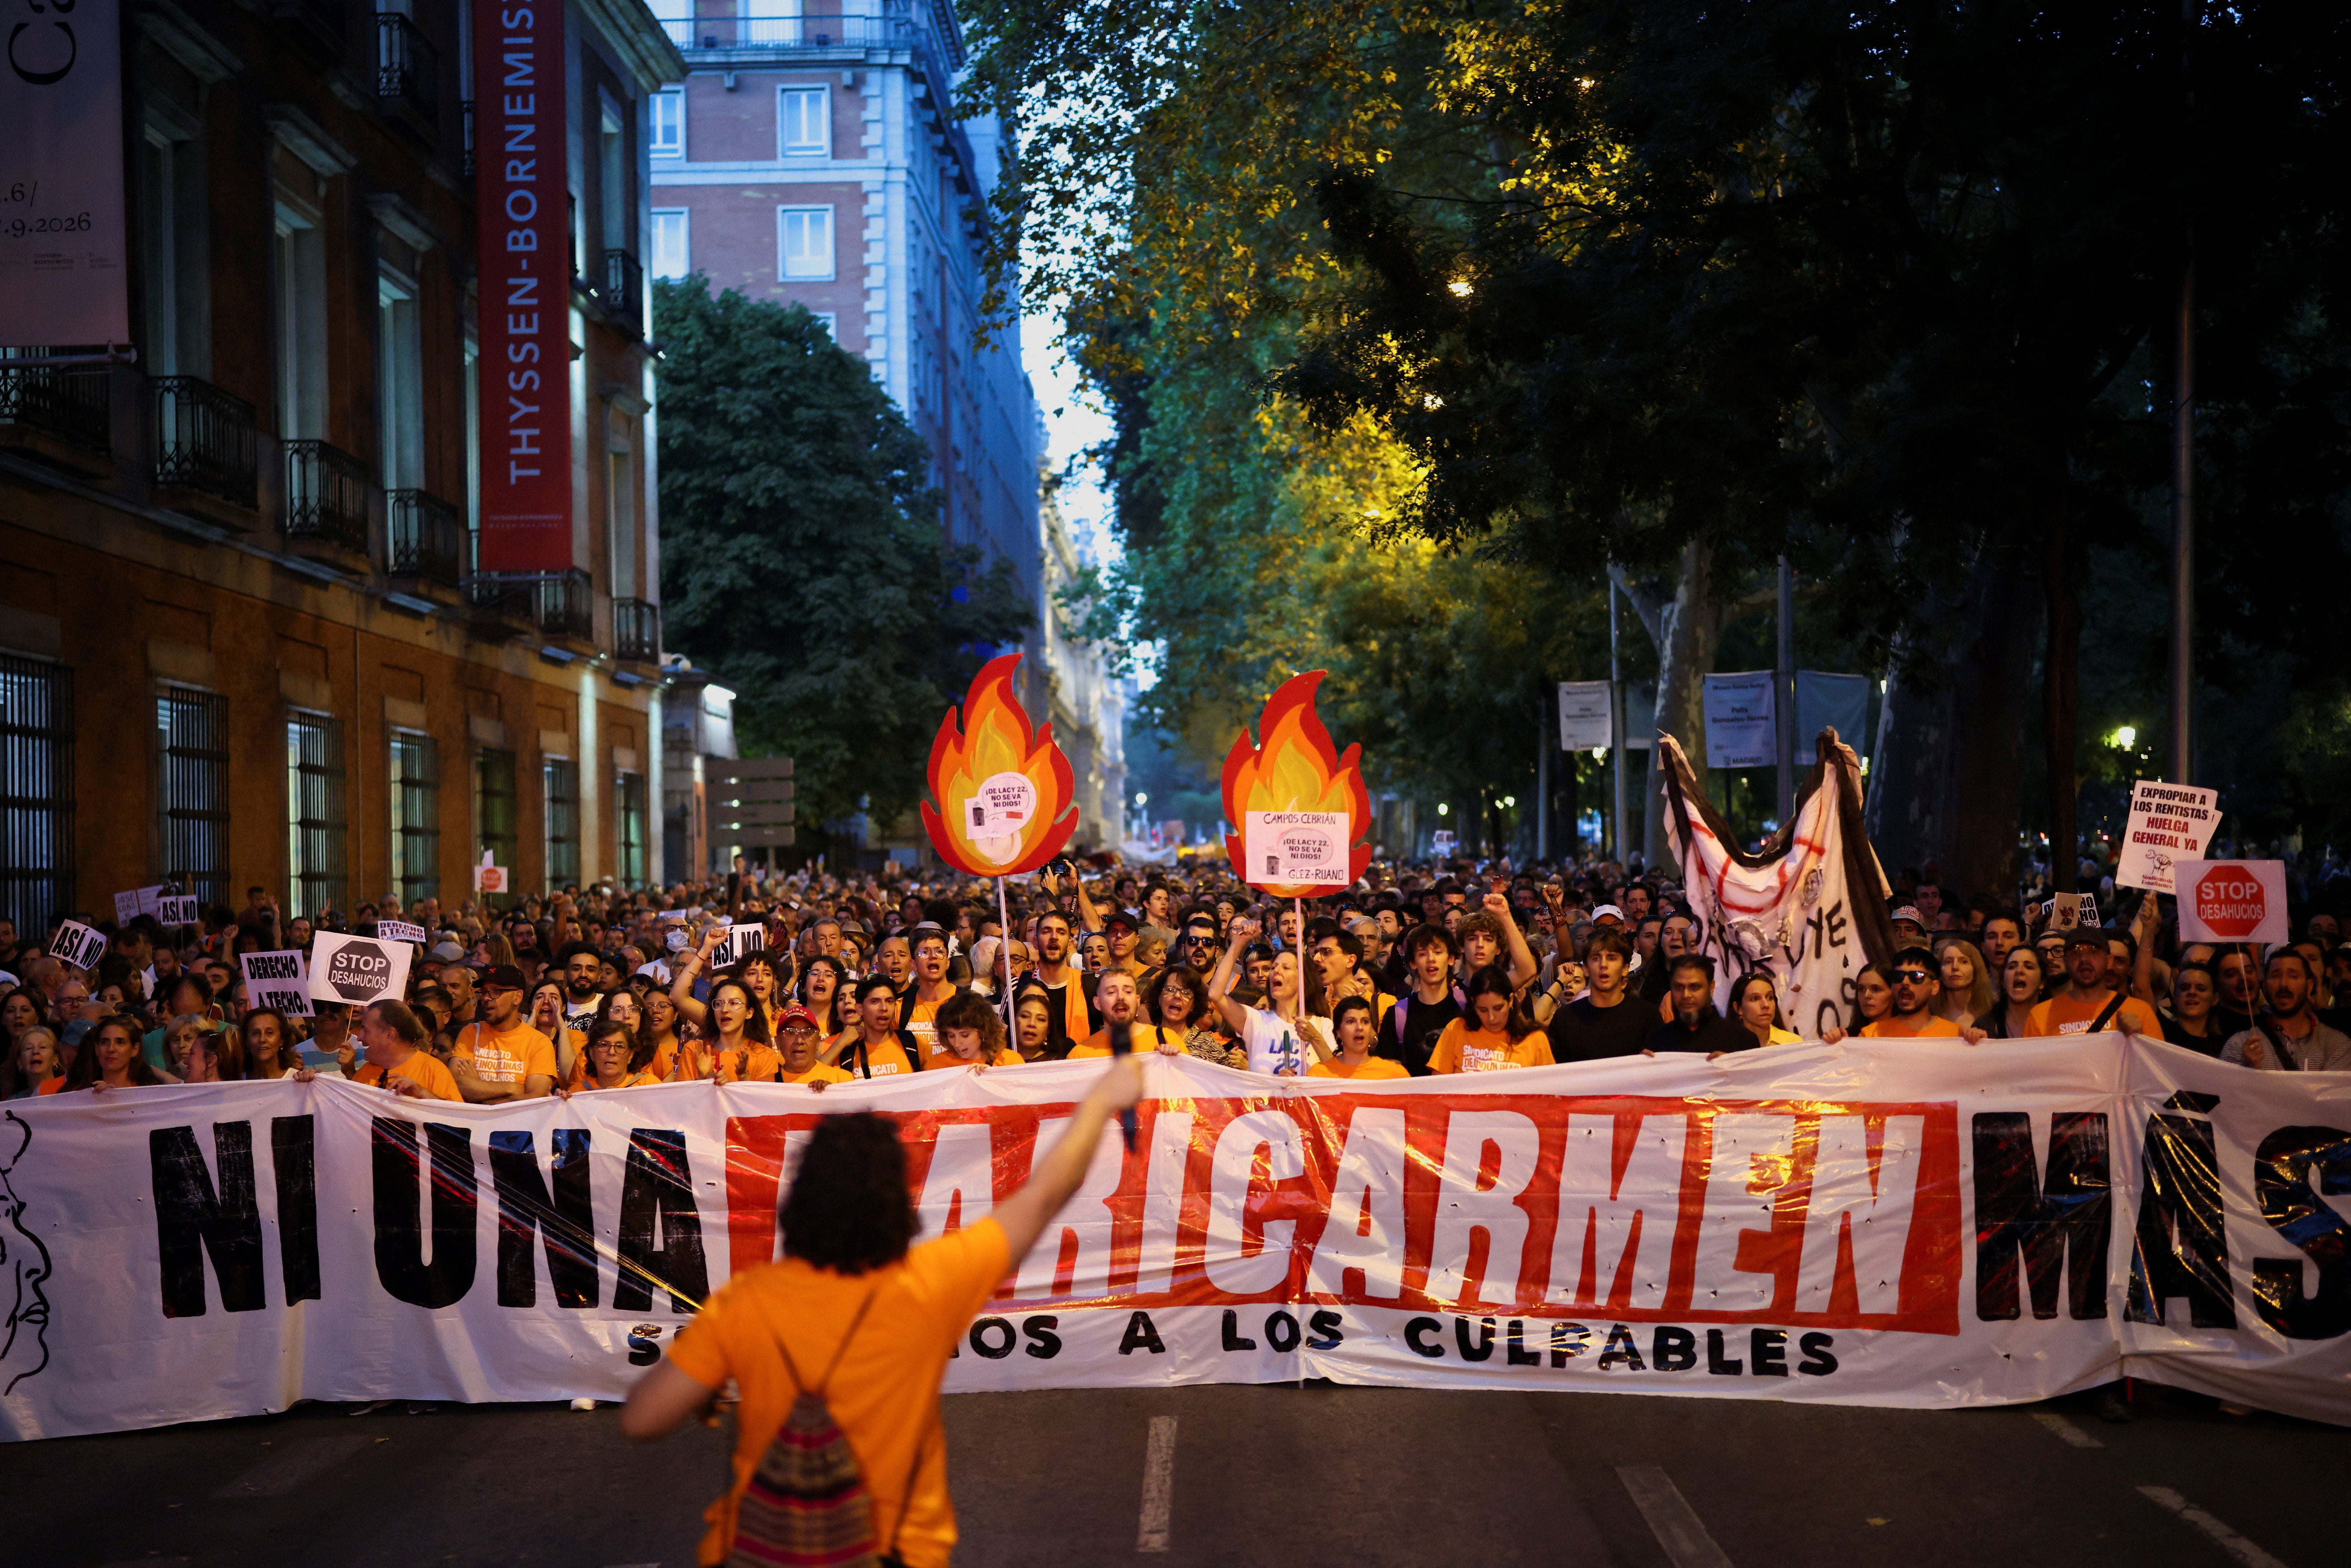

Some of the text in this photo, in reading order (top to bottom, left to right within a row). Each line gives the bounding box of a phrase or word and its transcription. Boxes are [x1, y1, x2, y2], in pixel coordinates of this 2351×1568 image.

[0, 212, 91, 238] .9.2026
[501, 0, 541, 485] THYSSEN-BORNEMIS
[2141, 787, 2206, 806] EXPROPIAR A
[1263, 813, 1336, 824] CAMPOS CEBRIÁN
[2134, 801, 2208, 820] LOS RENTISTAS
[2146, 817, 2189, 833] HUELGA
[2132, 831, 2197, 851] GENERAL YA
[2201, 882, 2258, 900] STOP
[163, 897, 181, 922] ASÍ,
[183, 901, 196, 921] NO
[2200, 904, 2263, 919] DESAHUCIOS
[380, 923, 422, 933] DERECHO
[388, 928, 423, 938] TECHO
[52, 926, 103, 968] ASÍ, NO
[741, 930, 762, 954] NO
[246, 955, 298, 980] DERECHO
[335, 952, 387, 972] STOP
[331, 970, 386, 990] DESAHUCIOS
[258, 991, 309, 1014] A TECHO.
[1463, 1045, 1505, 1061] SINDICATO
[854, 1063, 897, 1078] SIDICATO
[149, 1089, 2351, 1340] NI UNA ARICARMEN MÁS
[1118, 1308, 1839, 1377] A LOS CULPABLES
